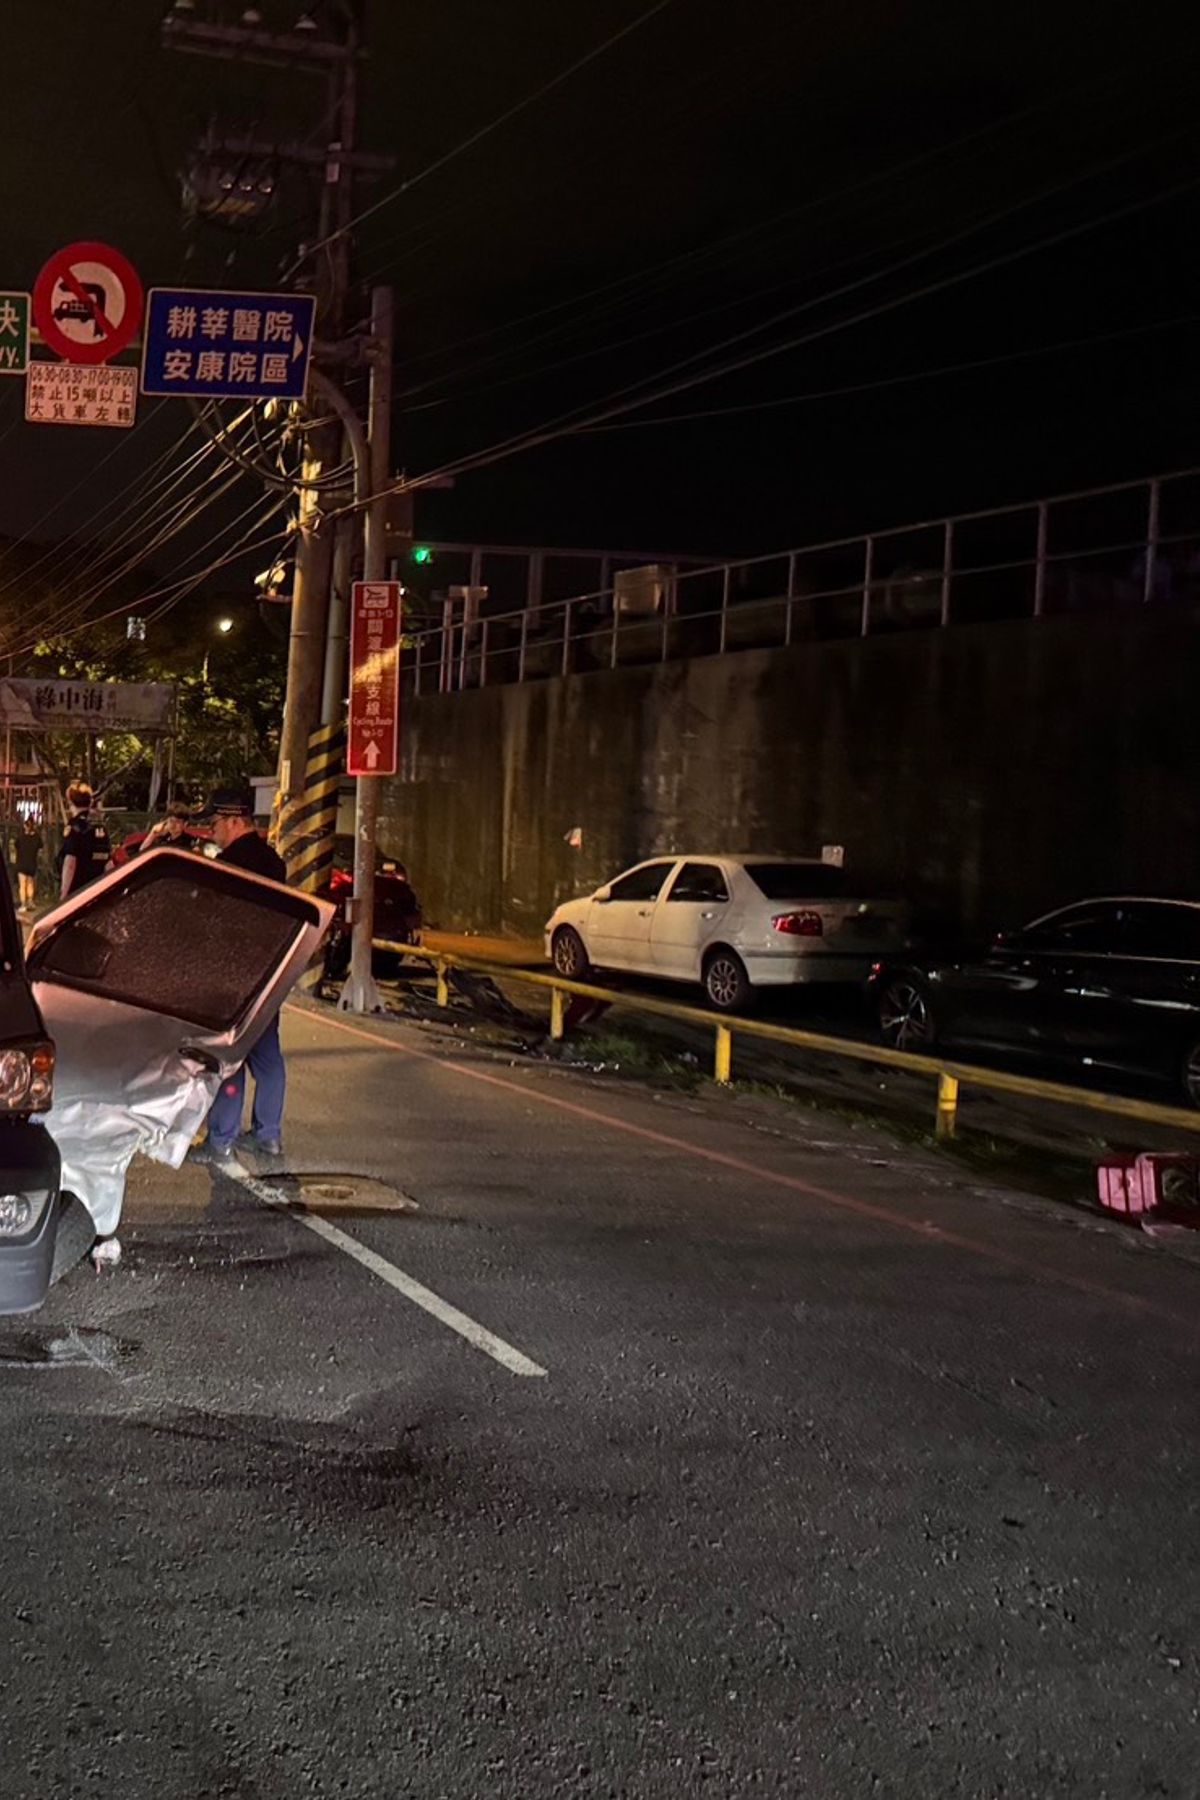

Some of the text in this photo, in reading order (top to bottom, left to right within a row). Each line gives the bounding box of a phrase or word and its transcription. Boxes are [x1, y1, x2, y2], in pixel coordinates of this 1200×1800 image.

[166, 305, 294, 342] 耕莘醫院
[163, 349, 290, 384] 安康院區
[31, 402, 130, 421] 大貨車左轉
